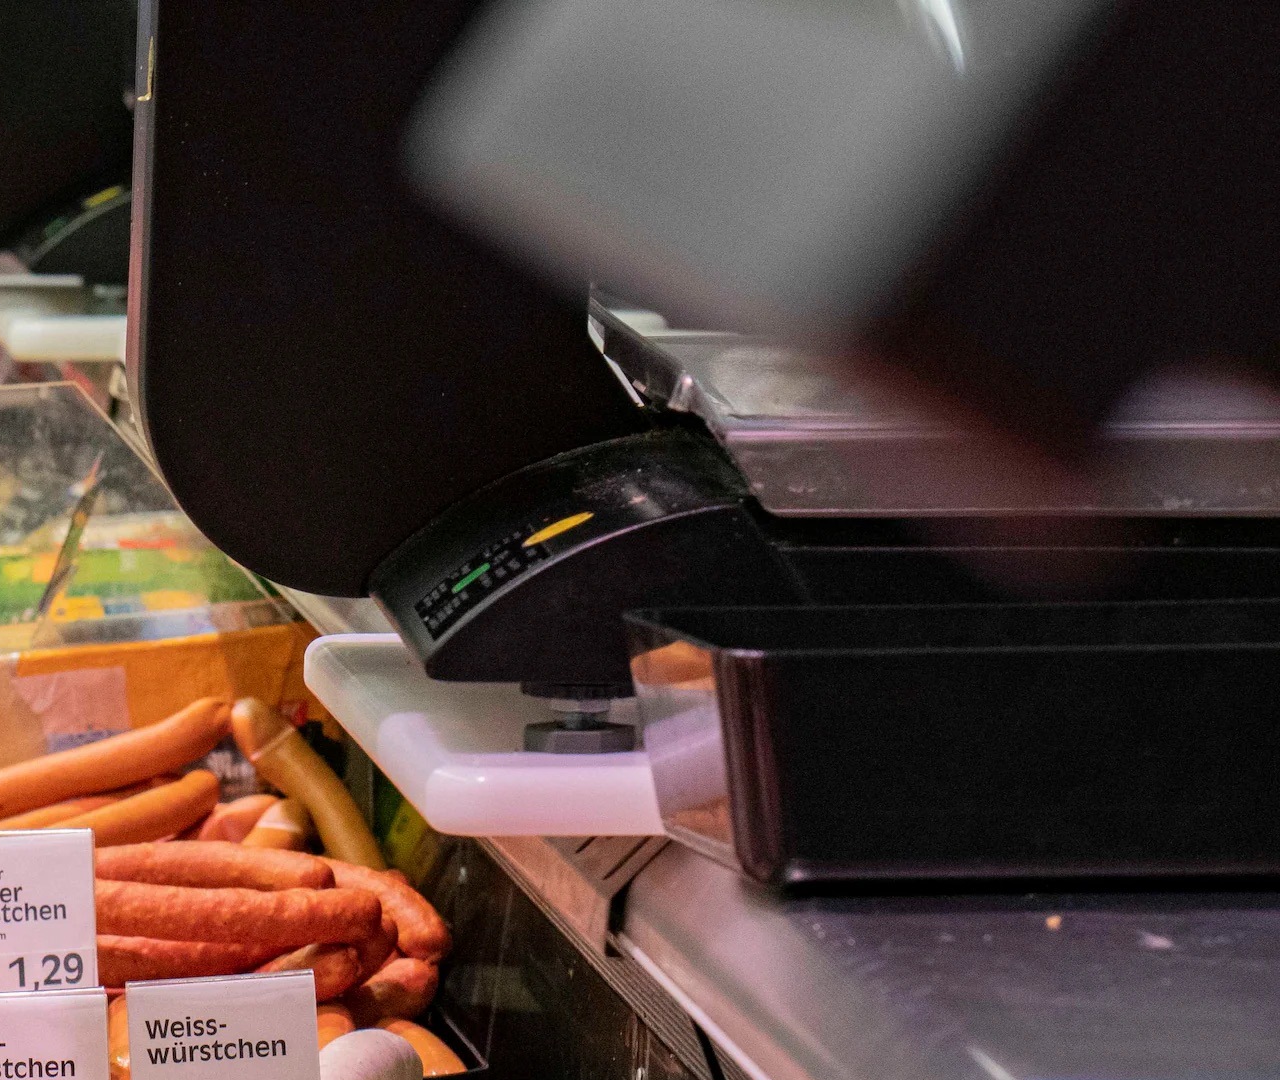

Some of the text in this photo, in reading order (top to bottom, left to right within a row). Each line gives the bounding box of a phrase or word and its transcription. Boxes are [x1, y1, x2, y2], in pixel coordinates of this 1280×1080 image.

[8, 952, 84, 991] 1,29
[145, 1016, 227, 1039] Weiss-
[147, 1038, 287, 1065] würstchen
